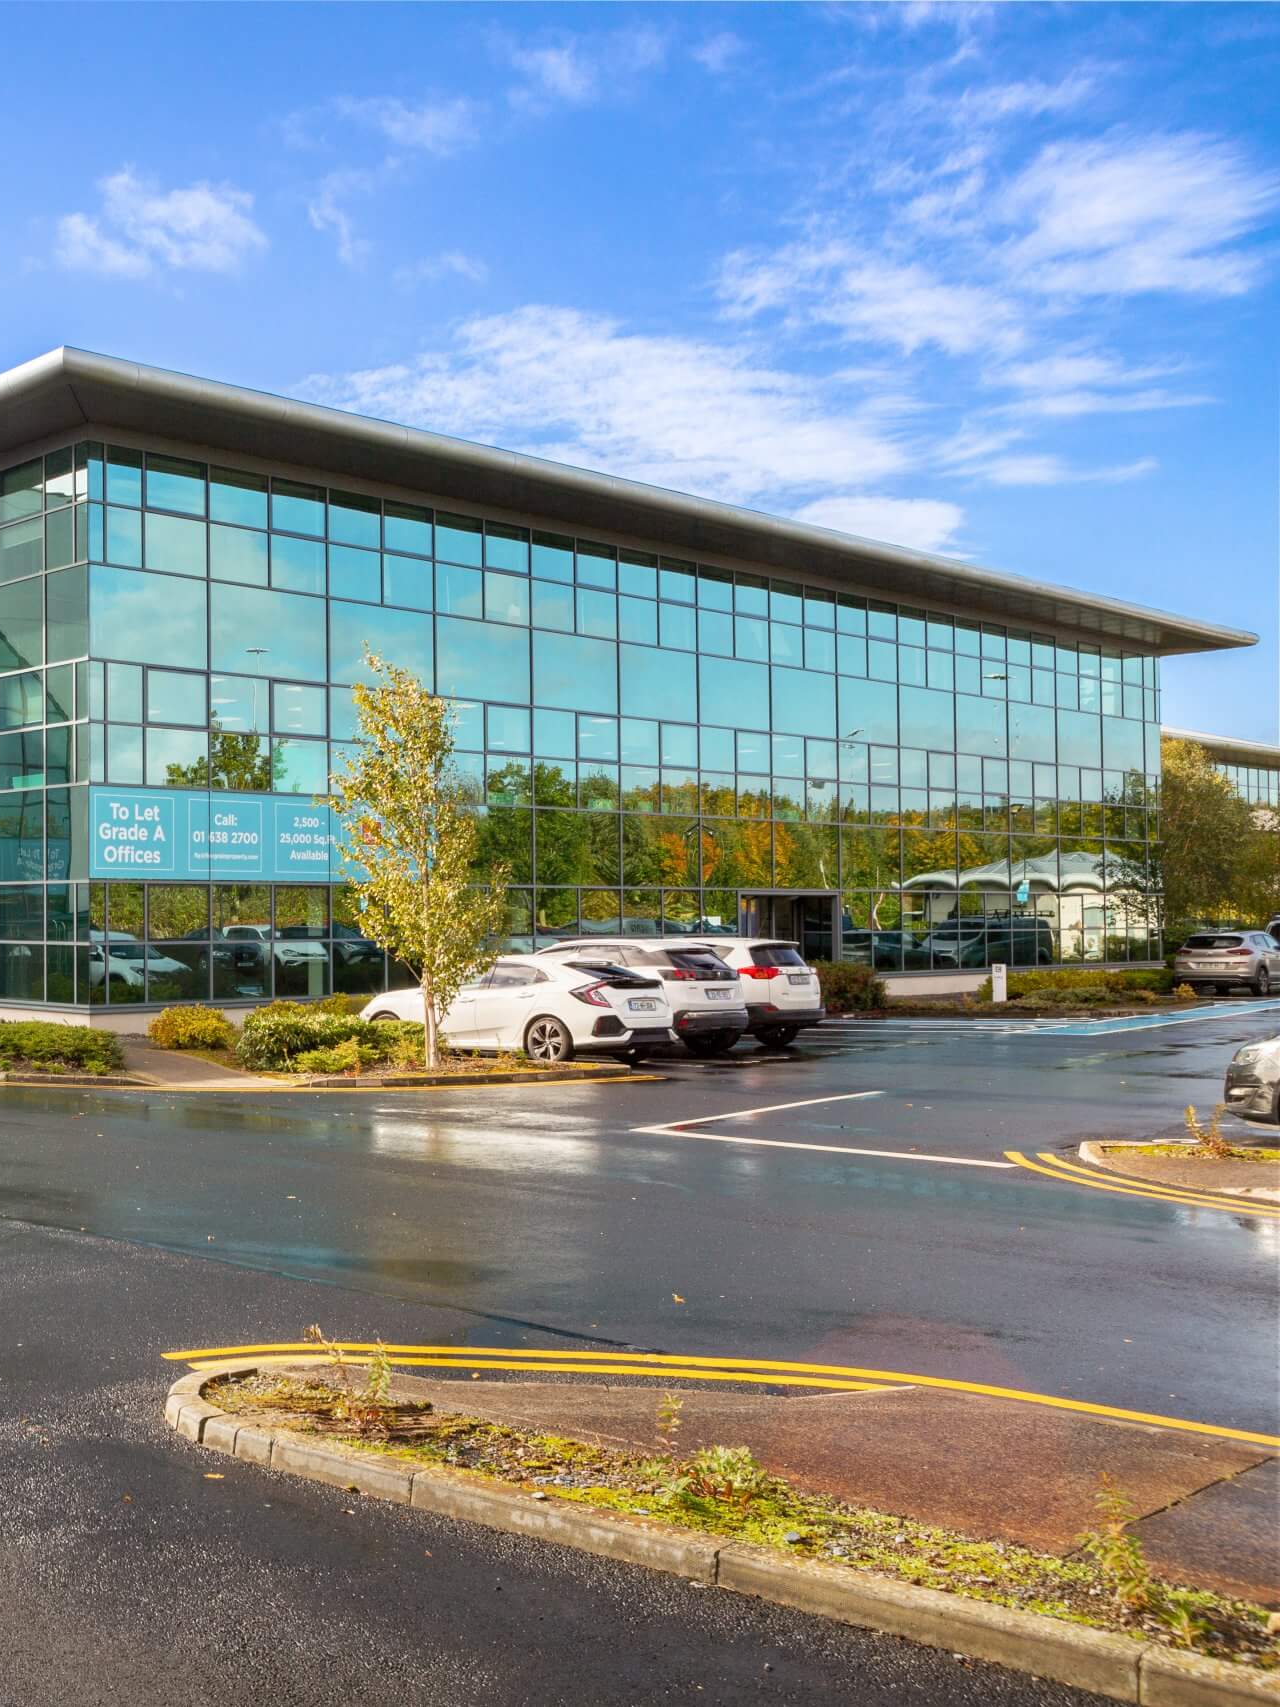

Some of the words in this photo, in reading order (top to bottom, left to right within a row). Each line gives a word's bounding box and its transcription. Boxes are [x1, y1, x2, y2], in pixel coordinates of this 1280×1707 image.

[110, 803, 129, 820] To
[135, 803, 160, 821] Let
[214, 814, 238, 826] Call:
[293, 817, 319, 828] 2,500
[99, 822, 148, 840] Grade
[153, 825, 166, 841] A
[193, 831, 205, 842] 01
[209, 831, 228, 843] 638
[231, 832, 258, 844] 2700
[280, 833, 312, 845] 25,000
[104, 845, 161, 863] Offices
[290, 849, 329, 860] Available
